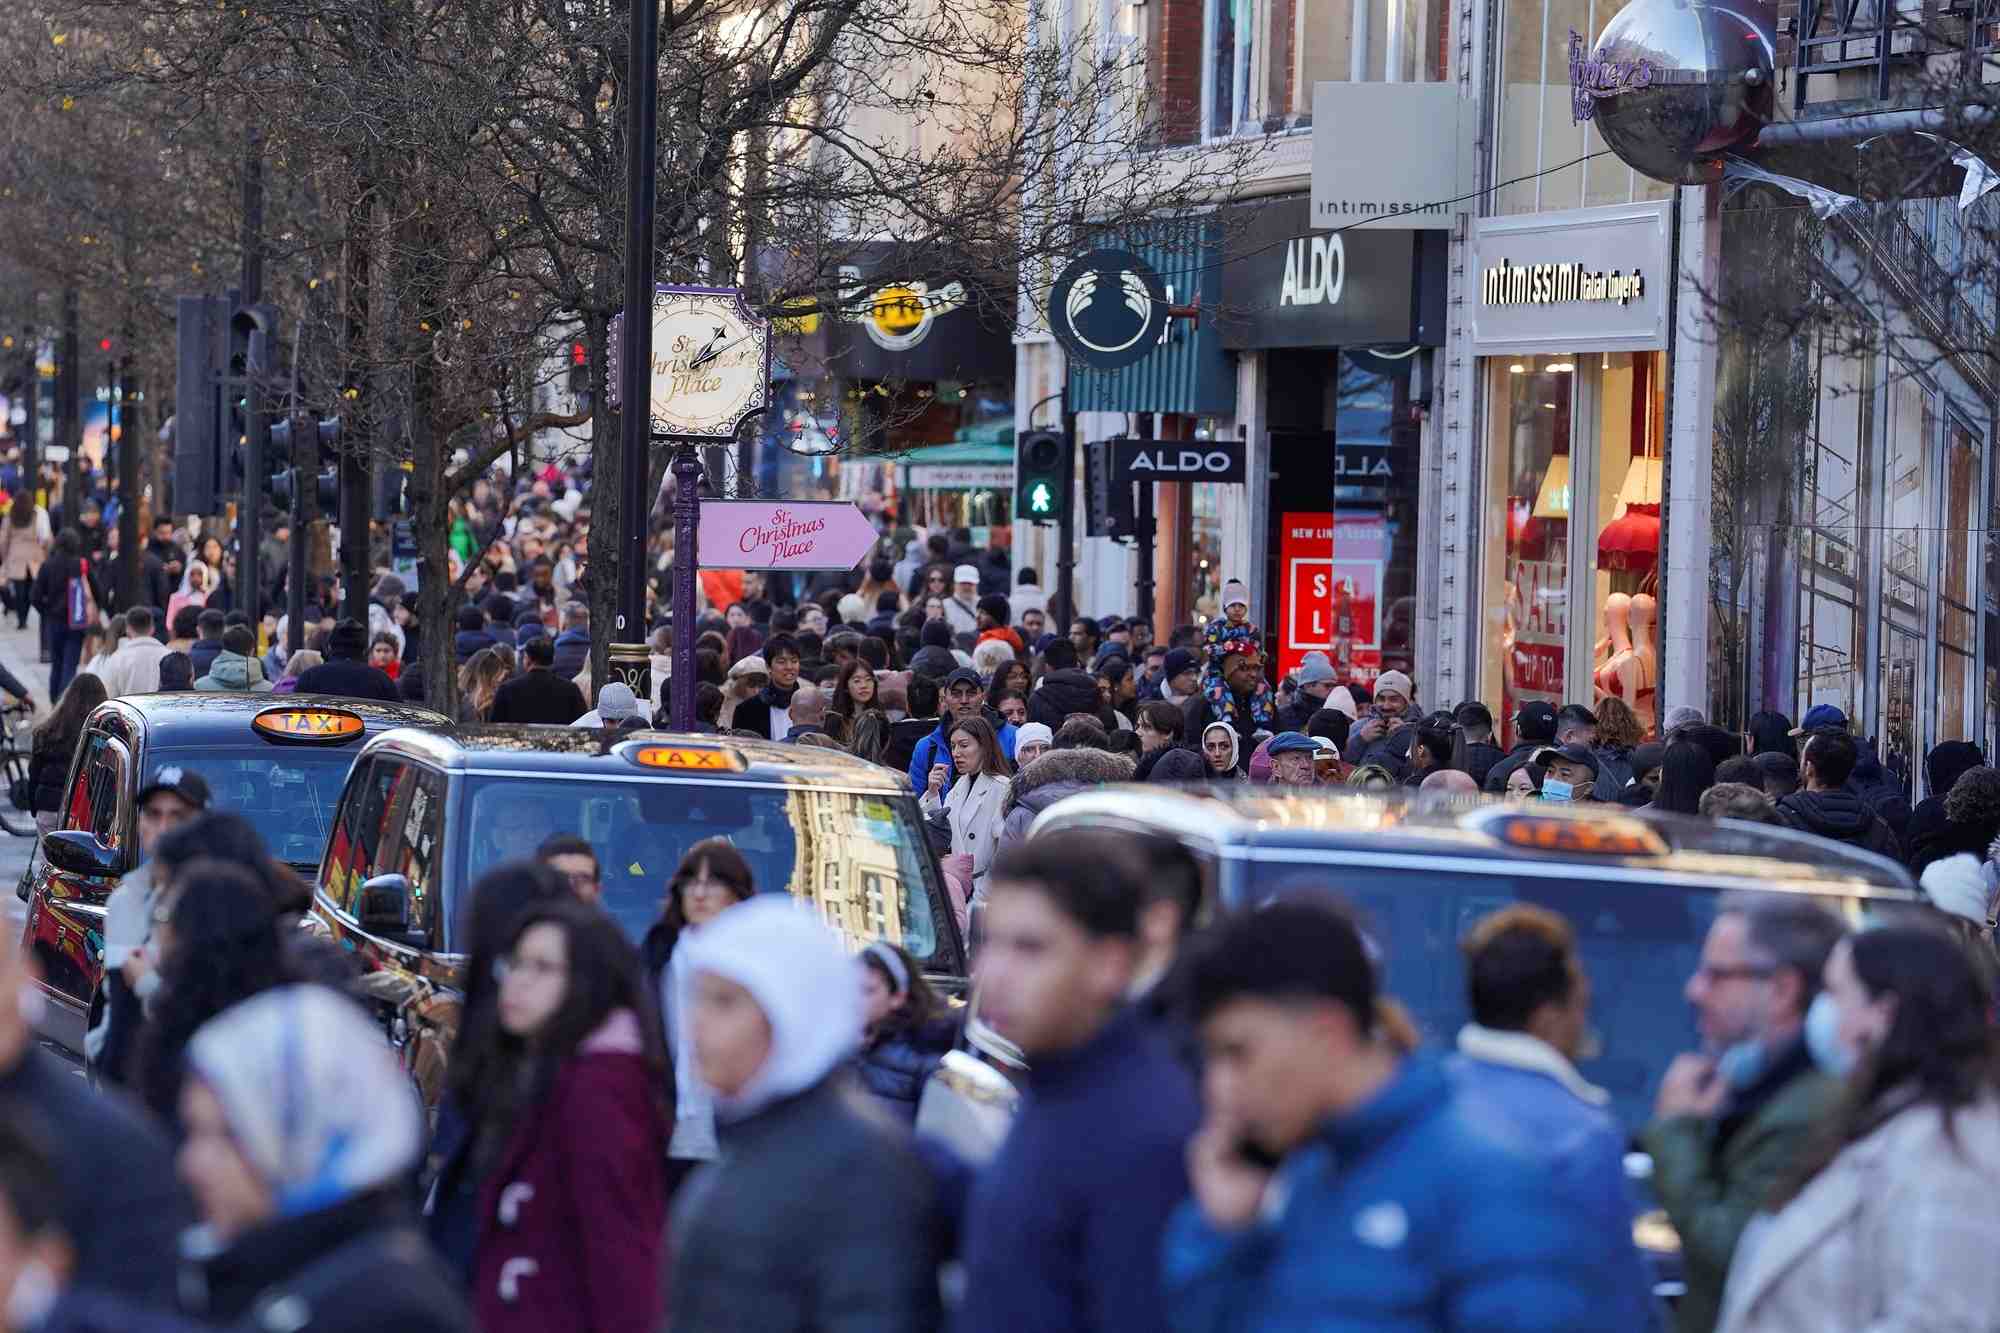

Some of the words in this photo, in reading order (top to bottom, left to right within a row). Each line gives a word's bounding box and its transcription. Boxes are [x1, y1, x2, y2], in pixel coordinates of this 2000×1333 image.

[1319, 198, 1448, 214] intimissimi
[1280, 233, 1345, 306] ALDO
[1482, 257, 1580, 304] intimissimi
[1129, 451, 1231, 473] ALDO
[771, 508, 792, 526] St
[739, 517, 826, 553] Christmas
[1292, 527, 1313, 539] NEW
[1524, 654, 1538, 683] UP
[1541, 656, 1556, 686] TO
[281, 714, 342, 732] TAXI
